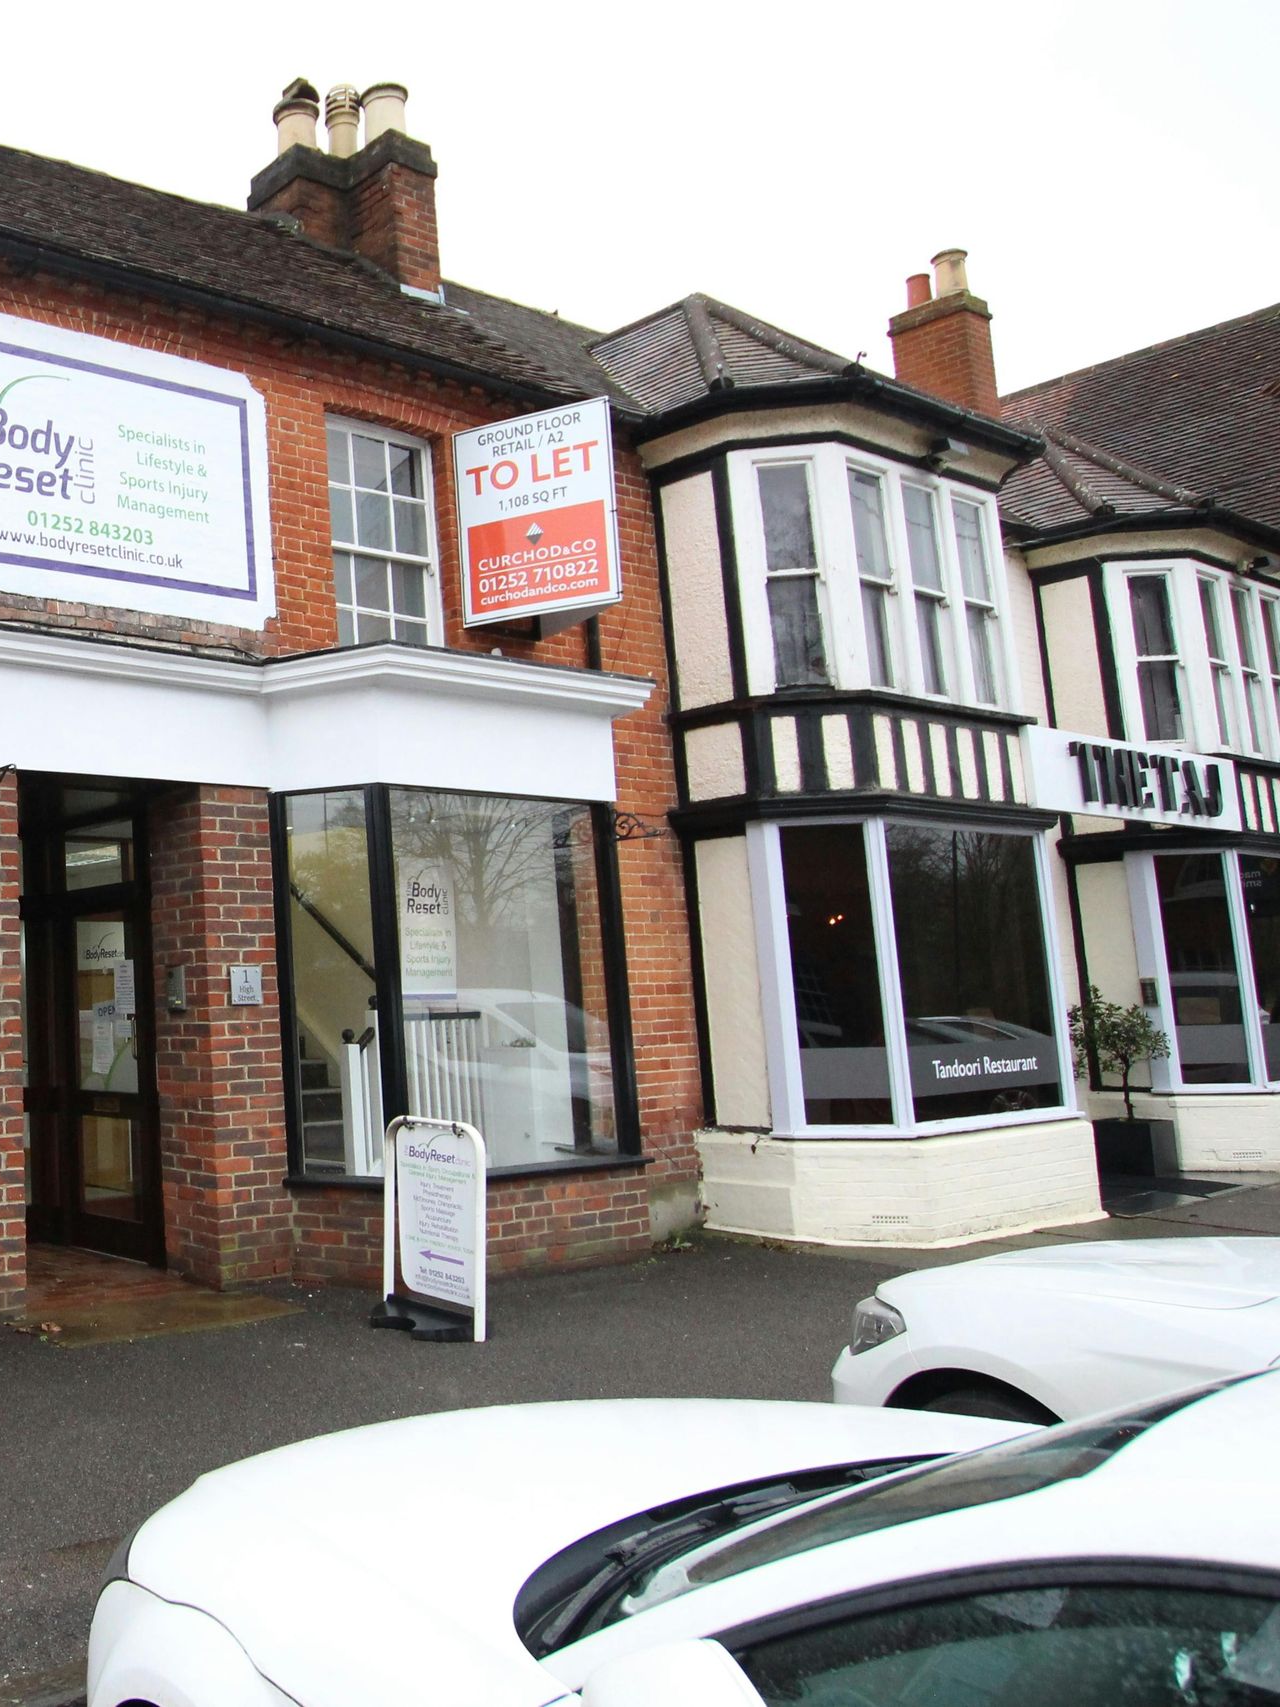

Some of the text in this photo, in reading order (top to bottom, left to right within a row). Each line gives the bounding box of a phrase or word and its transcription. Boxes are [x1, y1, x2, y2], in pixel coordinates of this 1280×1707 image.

[118, 424, 206, 455] Specialists in
[477, 411, 581, 447] GROUND FLOOR
[492, 440, 535, 458] RETAIL
[547, 430, 564, 446] A2
[73, 436, 96, 505] clinic
[136, 451, 207, 478] Lifestyle &
[465, 440, 599, 496] TO LET
[119, 471, 208, 504] Sports Injury
[498, 486, 568, 512] 1,108 SQ FT
[117, 494, 210, 524] Management
[27, 510, 154, 546] 01252 843203
[478, 538, 597, 572] CURCHOD&CO
[479, 558, 599, 594] 01252 710822
[480, 577, 599, 605] curchodandco.com
[407, 898, 441, 914] Reset
[411, 882, 441, 902] Body
[405, 967, 453, 979] Management
[406, 954, 429, 965] Sports
[239, 985, 254, 995] High
[243, 969, 250, 983] 1
[932, 1056, 1038, 1079] Tandoori Restaurant
